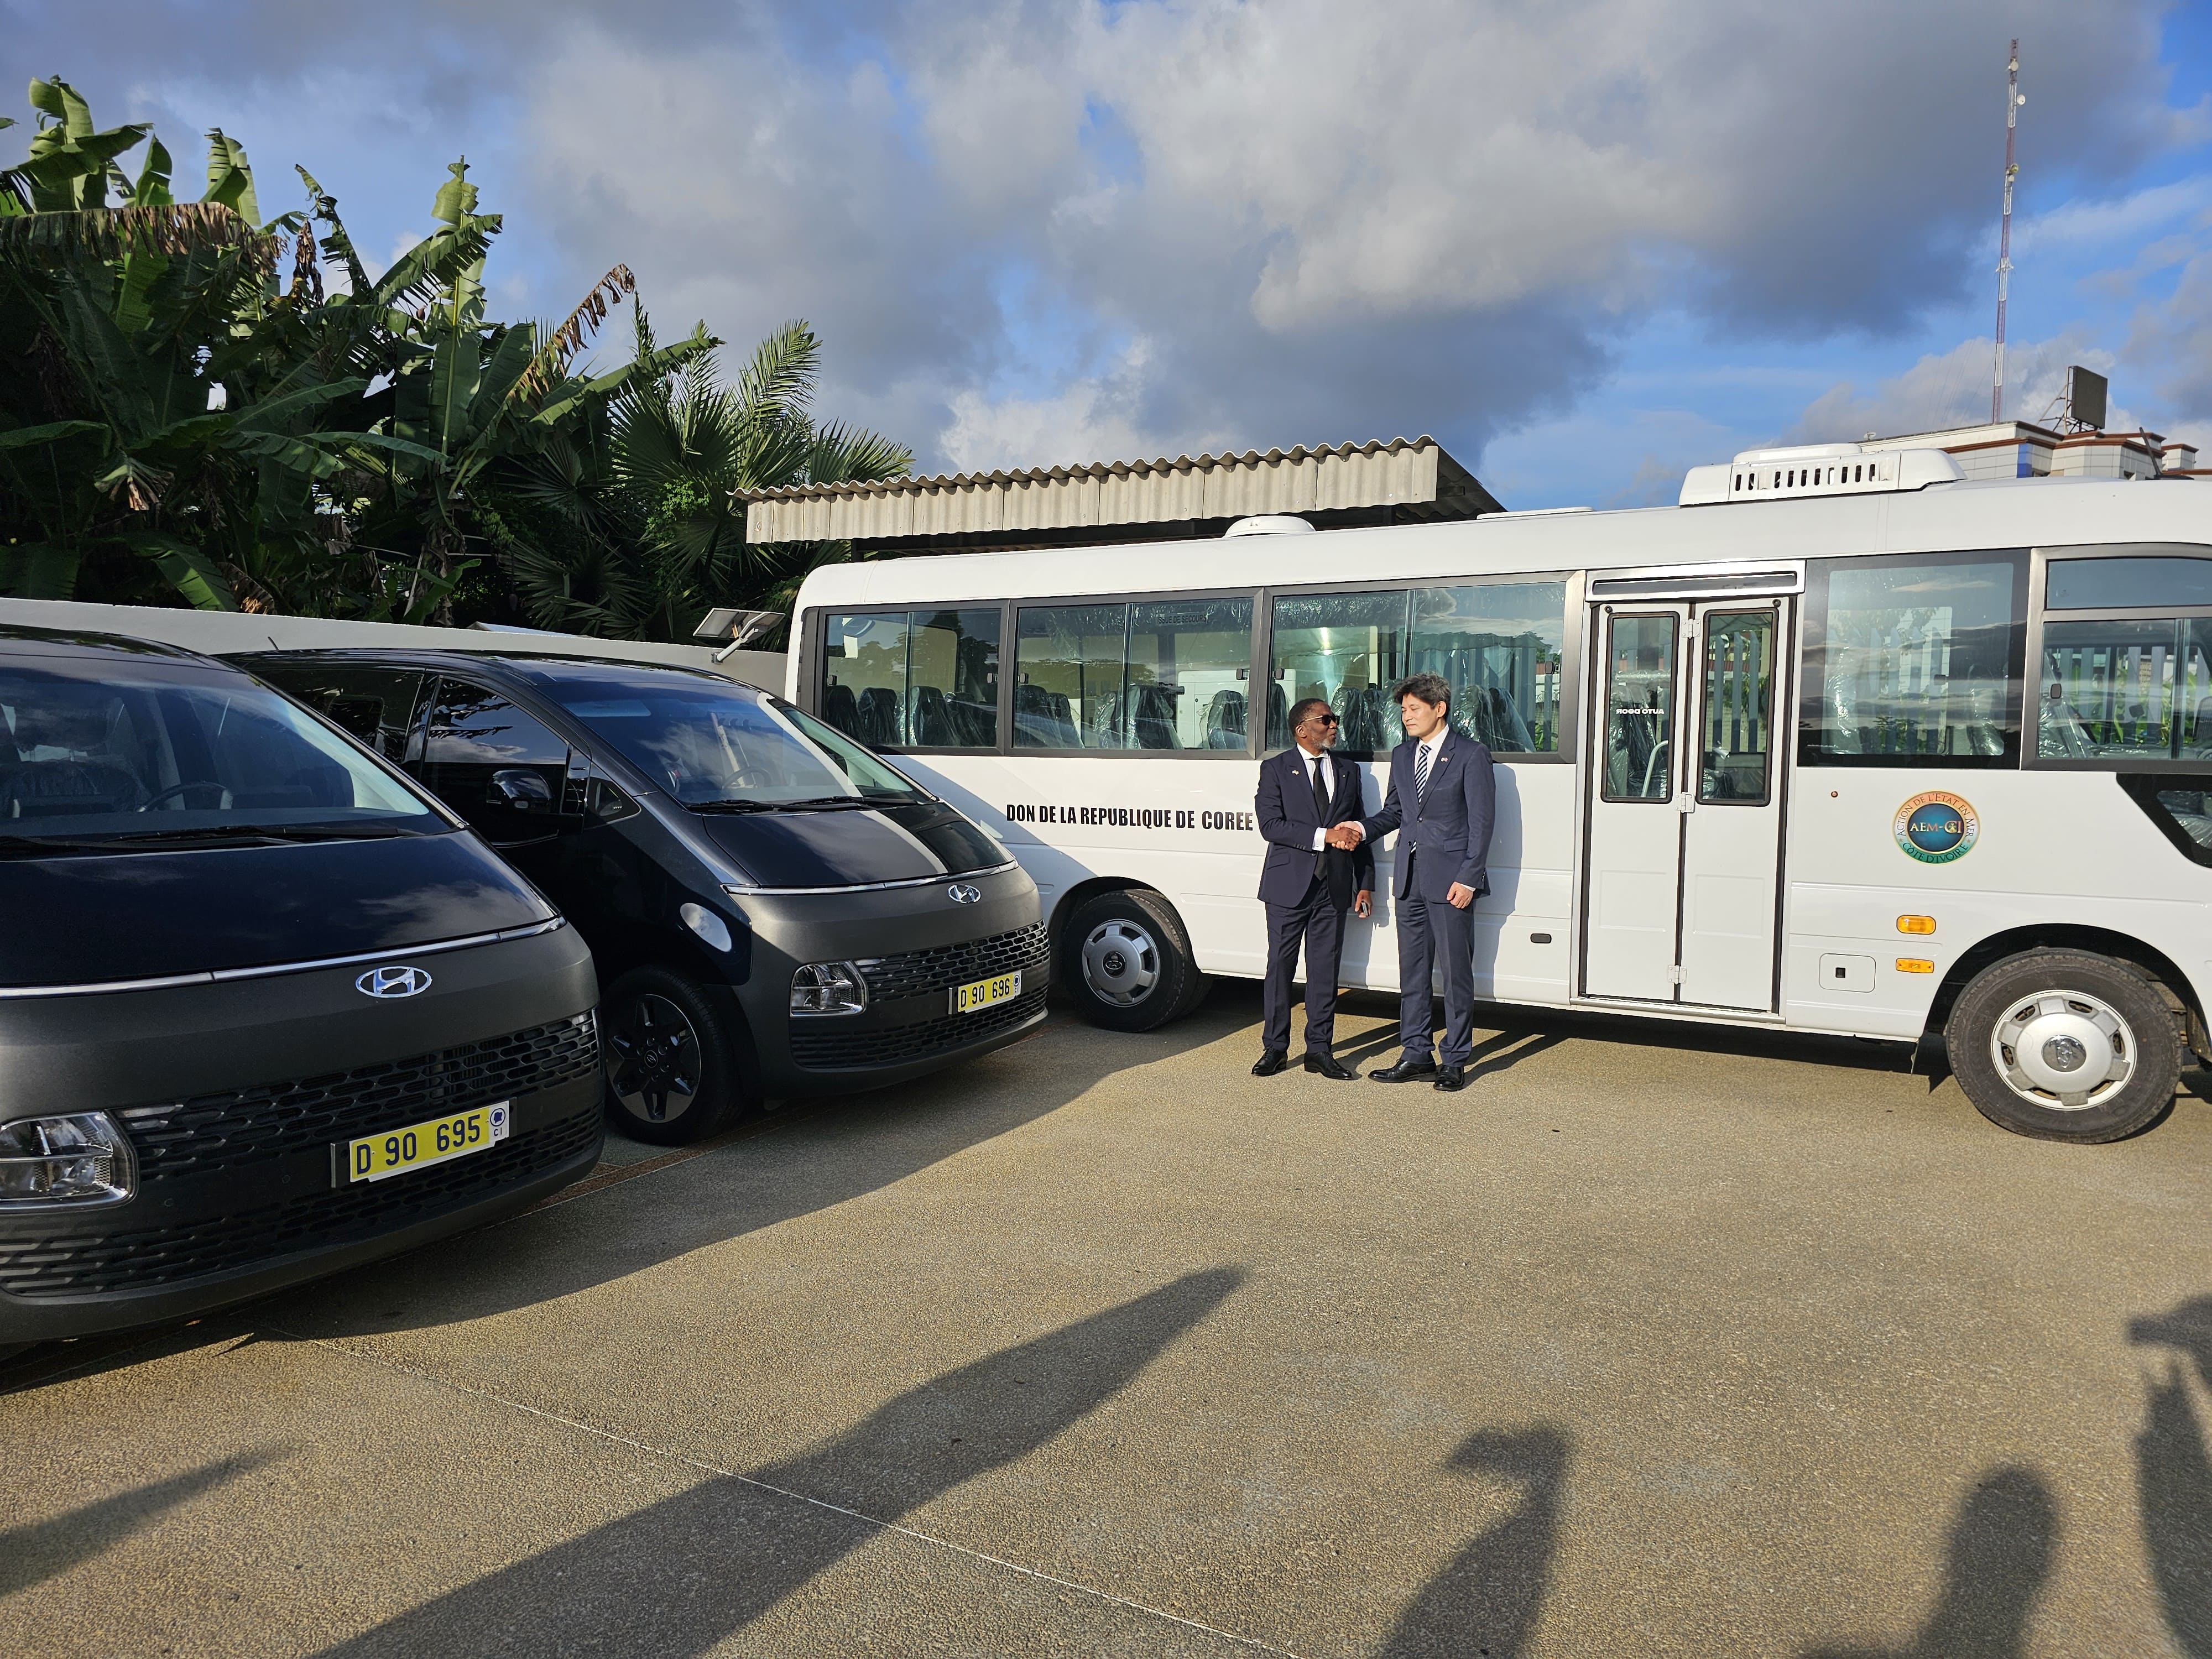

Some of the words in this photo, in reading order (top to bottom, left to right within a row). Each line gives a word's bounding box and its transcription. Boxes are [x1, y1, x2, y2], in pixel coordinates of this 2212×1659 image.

[1173, 615, 1181, 624] DE
[1182, 614, 1207, 623] SECOURS
[1006, 804, 1035, 822] DON
[1039, 805, 1056, 823] DE
[1060, 806, 1077, 824] LA
[1080, 807, 1172, 829] REPUBLIQUE
[1176, 810, 1195, 829] DE
[1202, 811, 1253, 831] COREE
[1897, 804, 1913, 837] ACTION
[1913, 796, 1926, 806] DE
[1958, 805, 1970, 816] EN
[1965, 818, 1976, 837] MER
[1909, 820, 1962, 833] AEM-CI
[1926, 844, 1969, 864] D'IVOIRE
[961, 989, 967, 1008] D
[972, 984, 984, 1004] 90
[992, 978, 1010, 999] 696
[493, 1128, 503, 1137] CI
[356, 1143, 371, 1175] D
[385, 1131, 416, 1166] 90
[436, 1114, 481, 1152] 695
